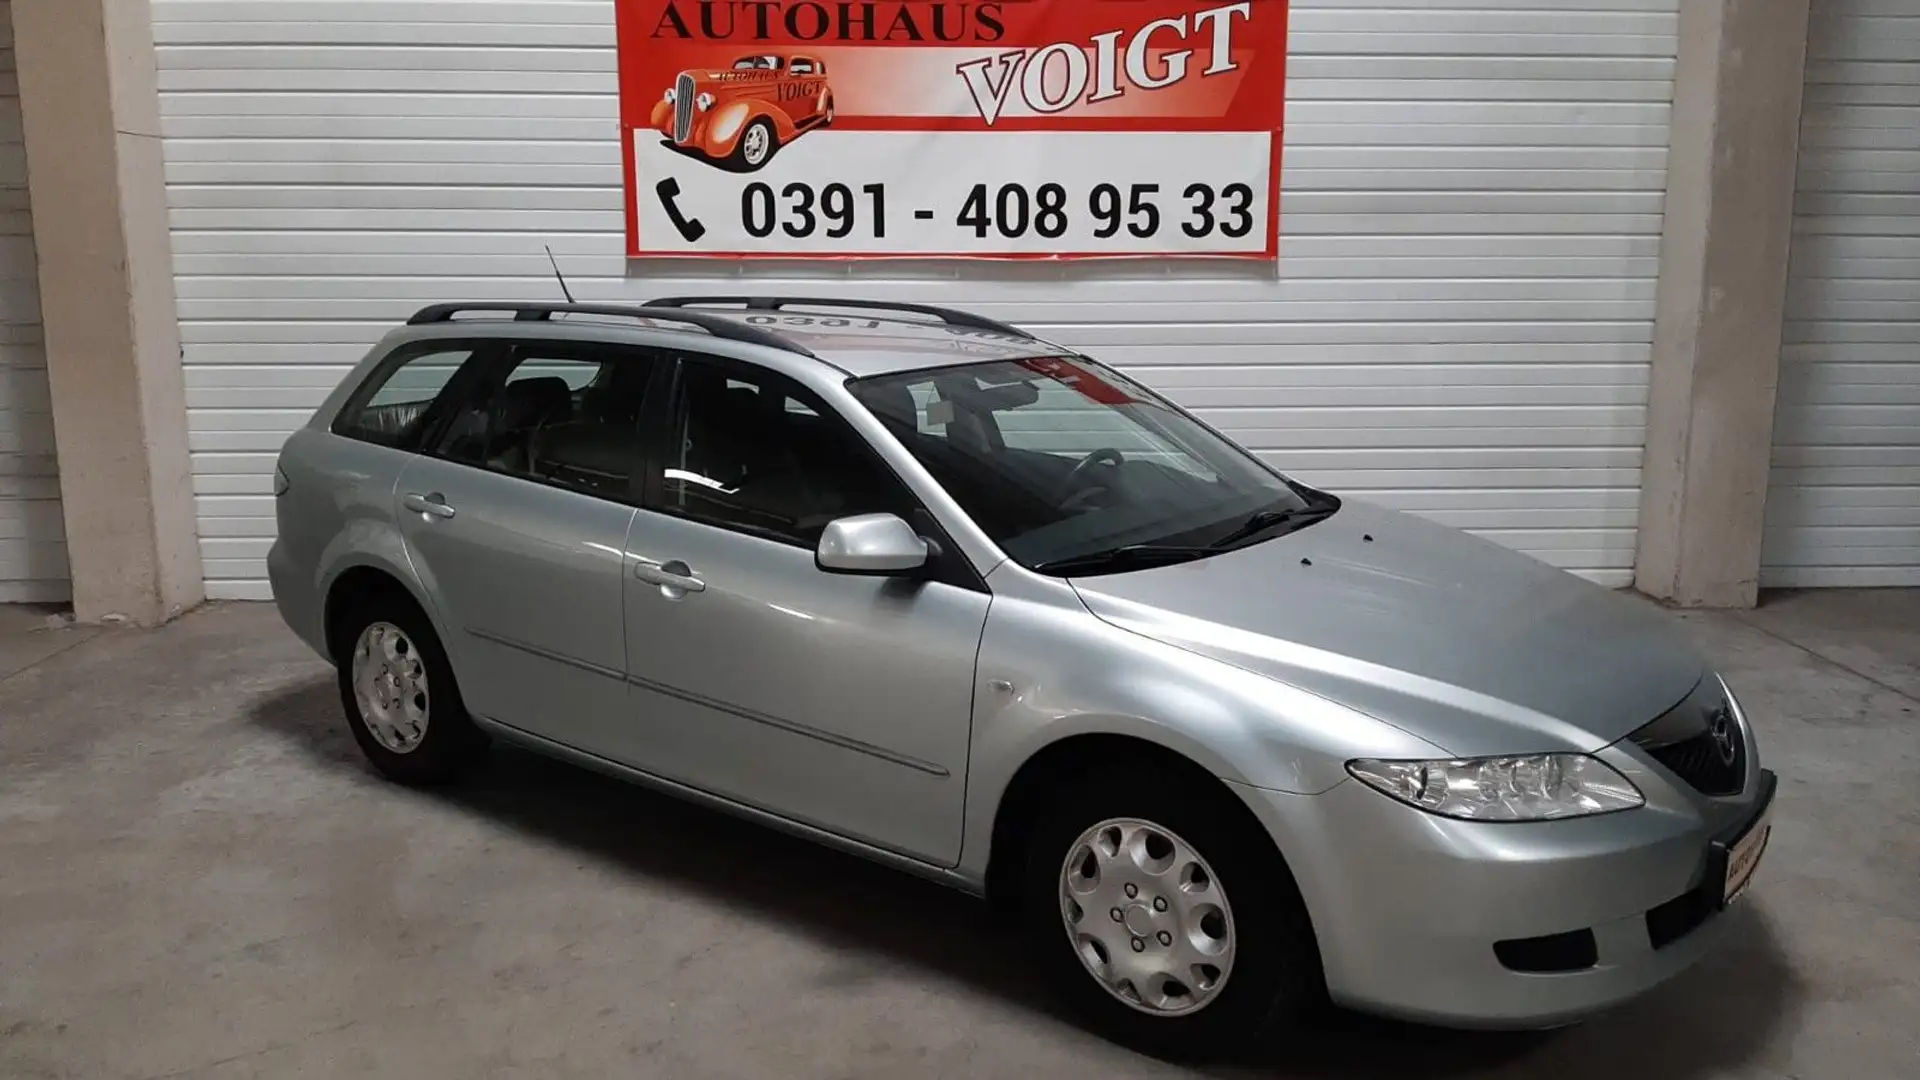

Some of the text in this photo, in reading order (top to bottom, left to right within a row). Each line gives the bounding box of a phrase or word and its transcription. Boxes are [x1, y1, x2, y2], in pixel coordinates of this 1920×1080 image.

[650, 0, 1251, 126] AUTOHAUS VOIGT
[777, 81, 823, 102] VOIGT
[741, 182, 1253, 239] 0391 - 408 95 33
